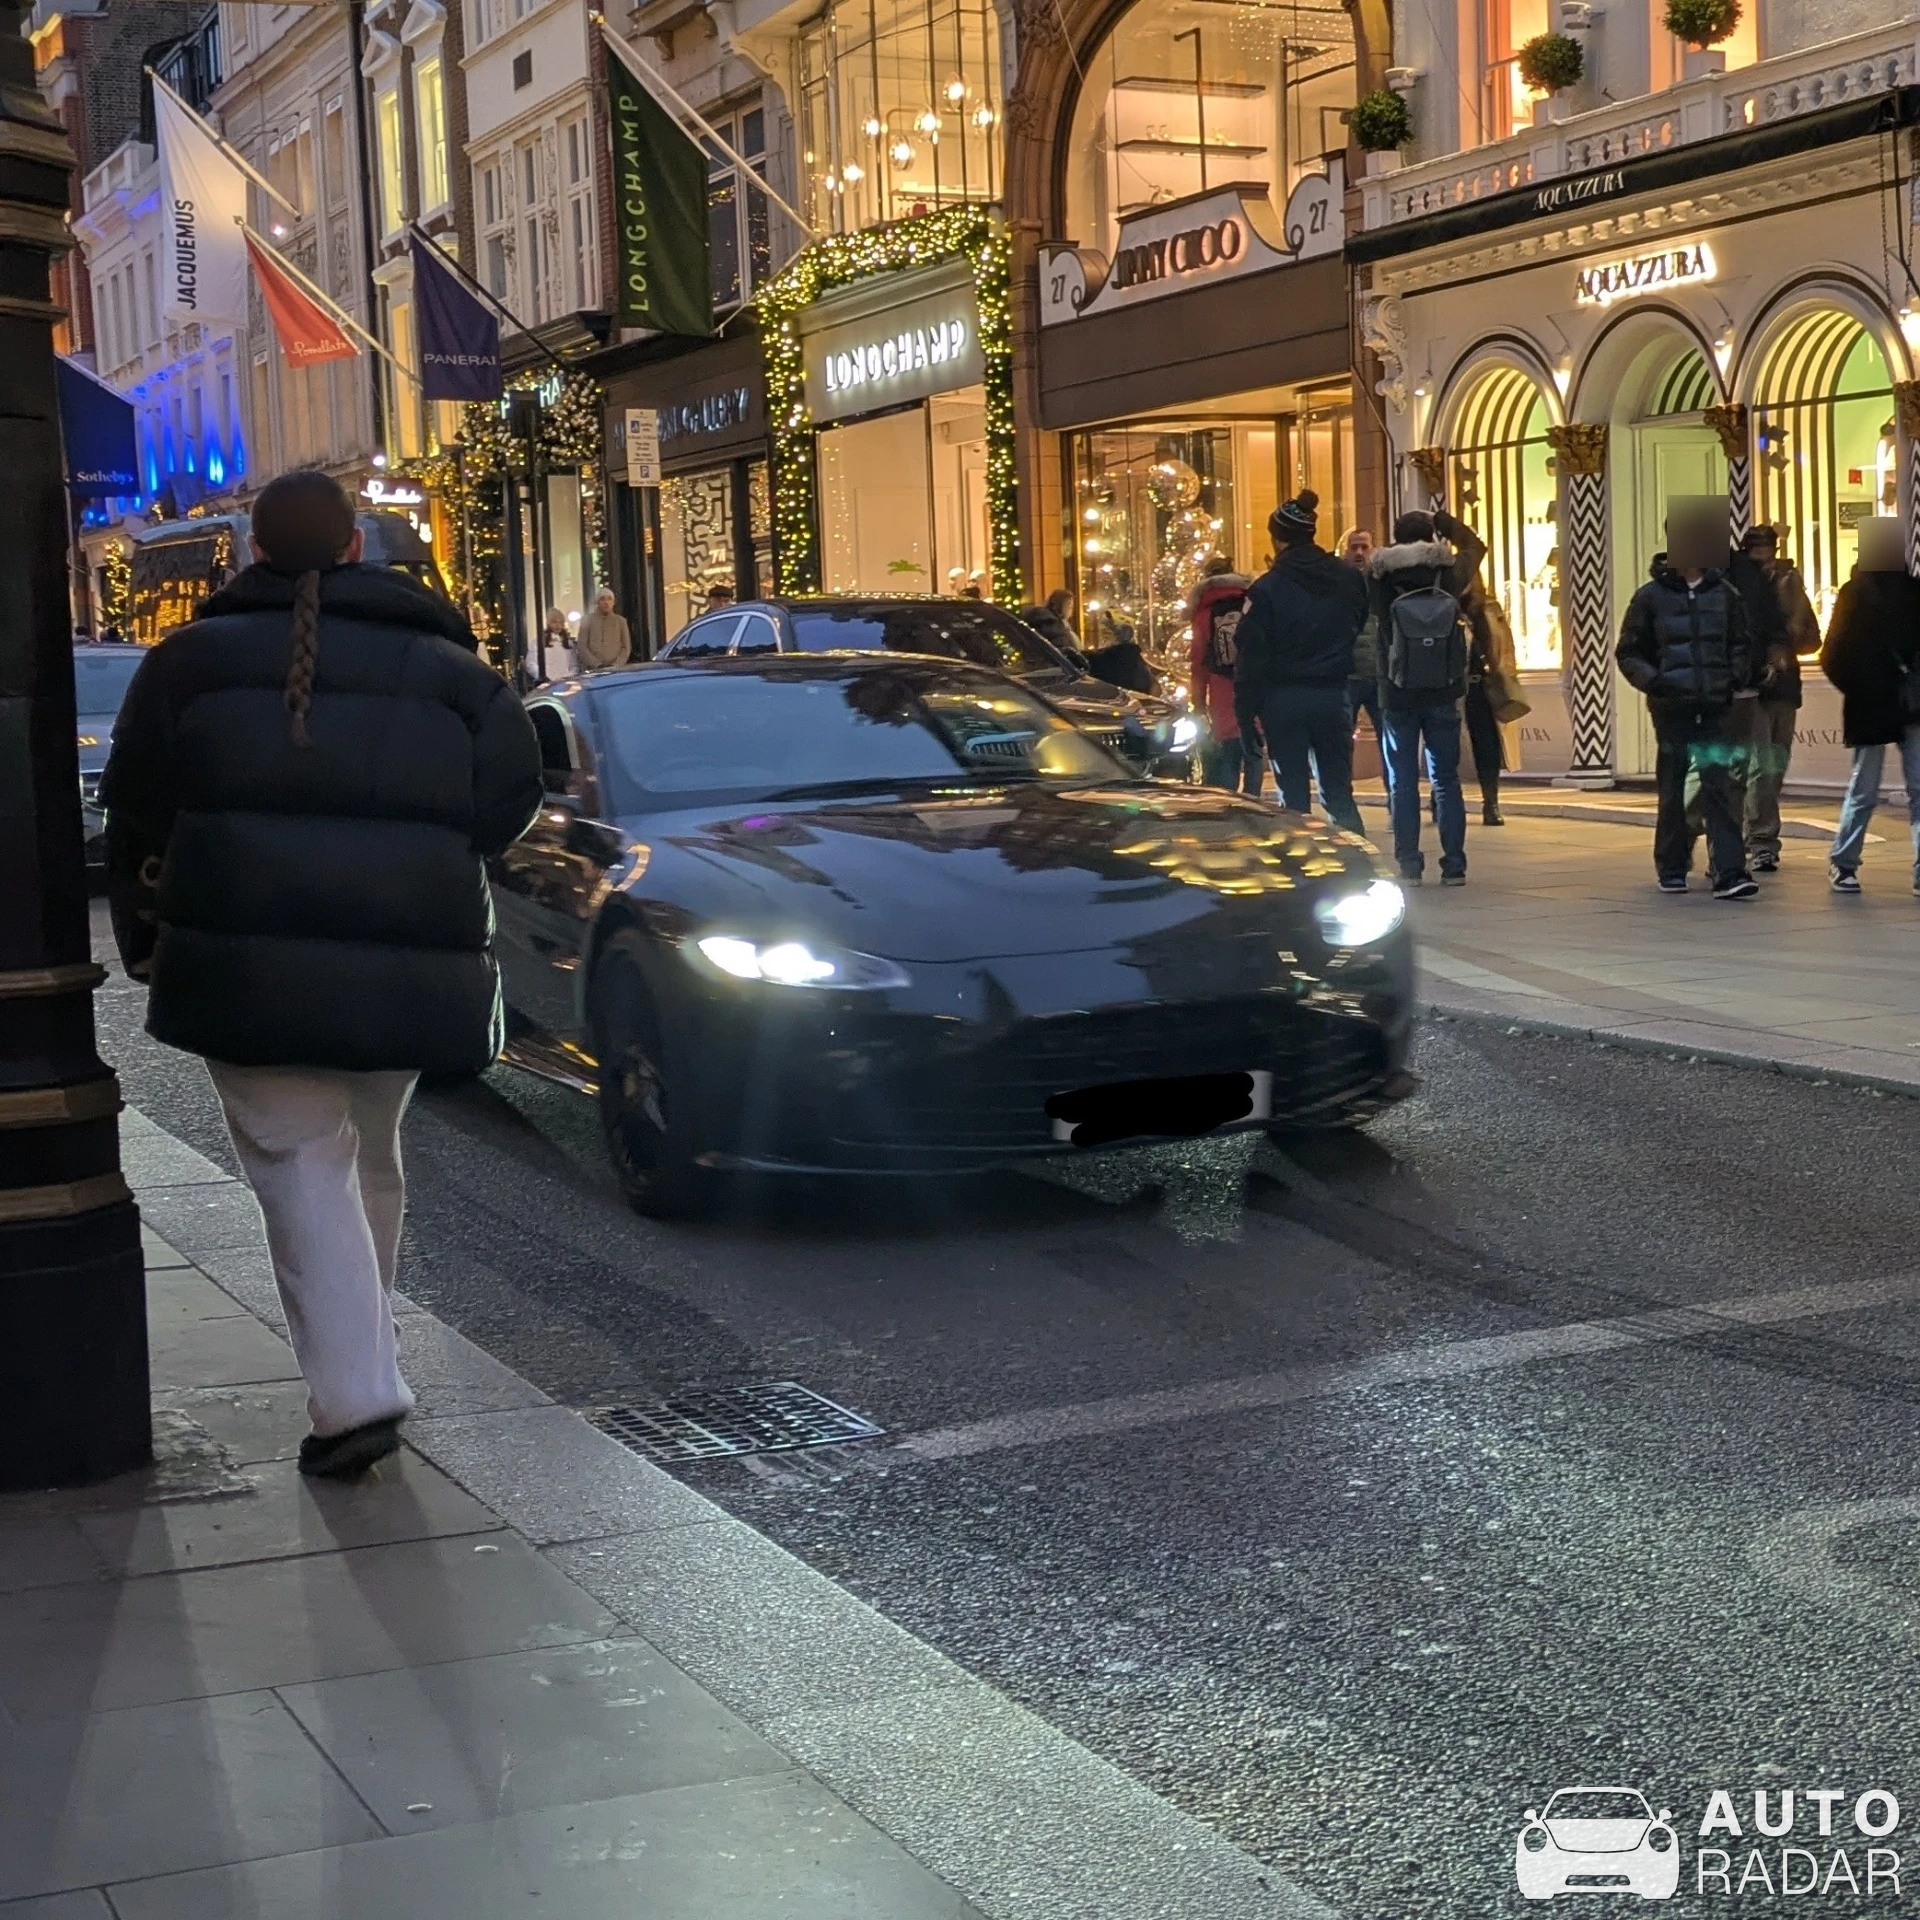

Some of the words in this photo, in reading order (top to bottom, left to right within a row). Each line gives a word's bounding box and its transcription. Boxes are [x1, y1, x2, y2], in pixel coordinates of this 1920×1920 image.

[619, 95, 649, 316] LONGCHAMP
[1309, 199, 1328, 234] 27
[1533, 171, 1625, 211] AQUAZZURA
[175, 199, 197, 310] JACQUEMUS
[1111, 239, 1168, 290] JIMMY
[1169, 219, 1241, 273] CHOO
[1573, 244, 1707, 302] AQUAZZURA
[1051, 274, 1066, 304] 27
[423, 353, 497, 366] PANERAI
[825, 319, 965, 392] LONGCHAMP
